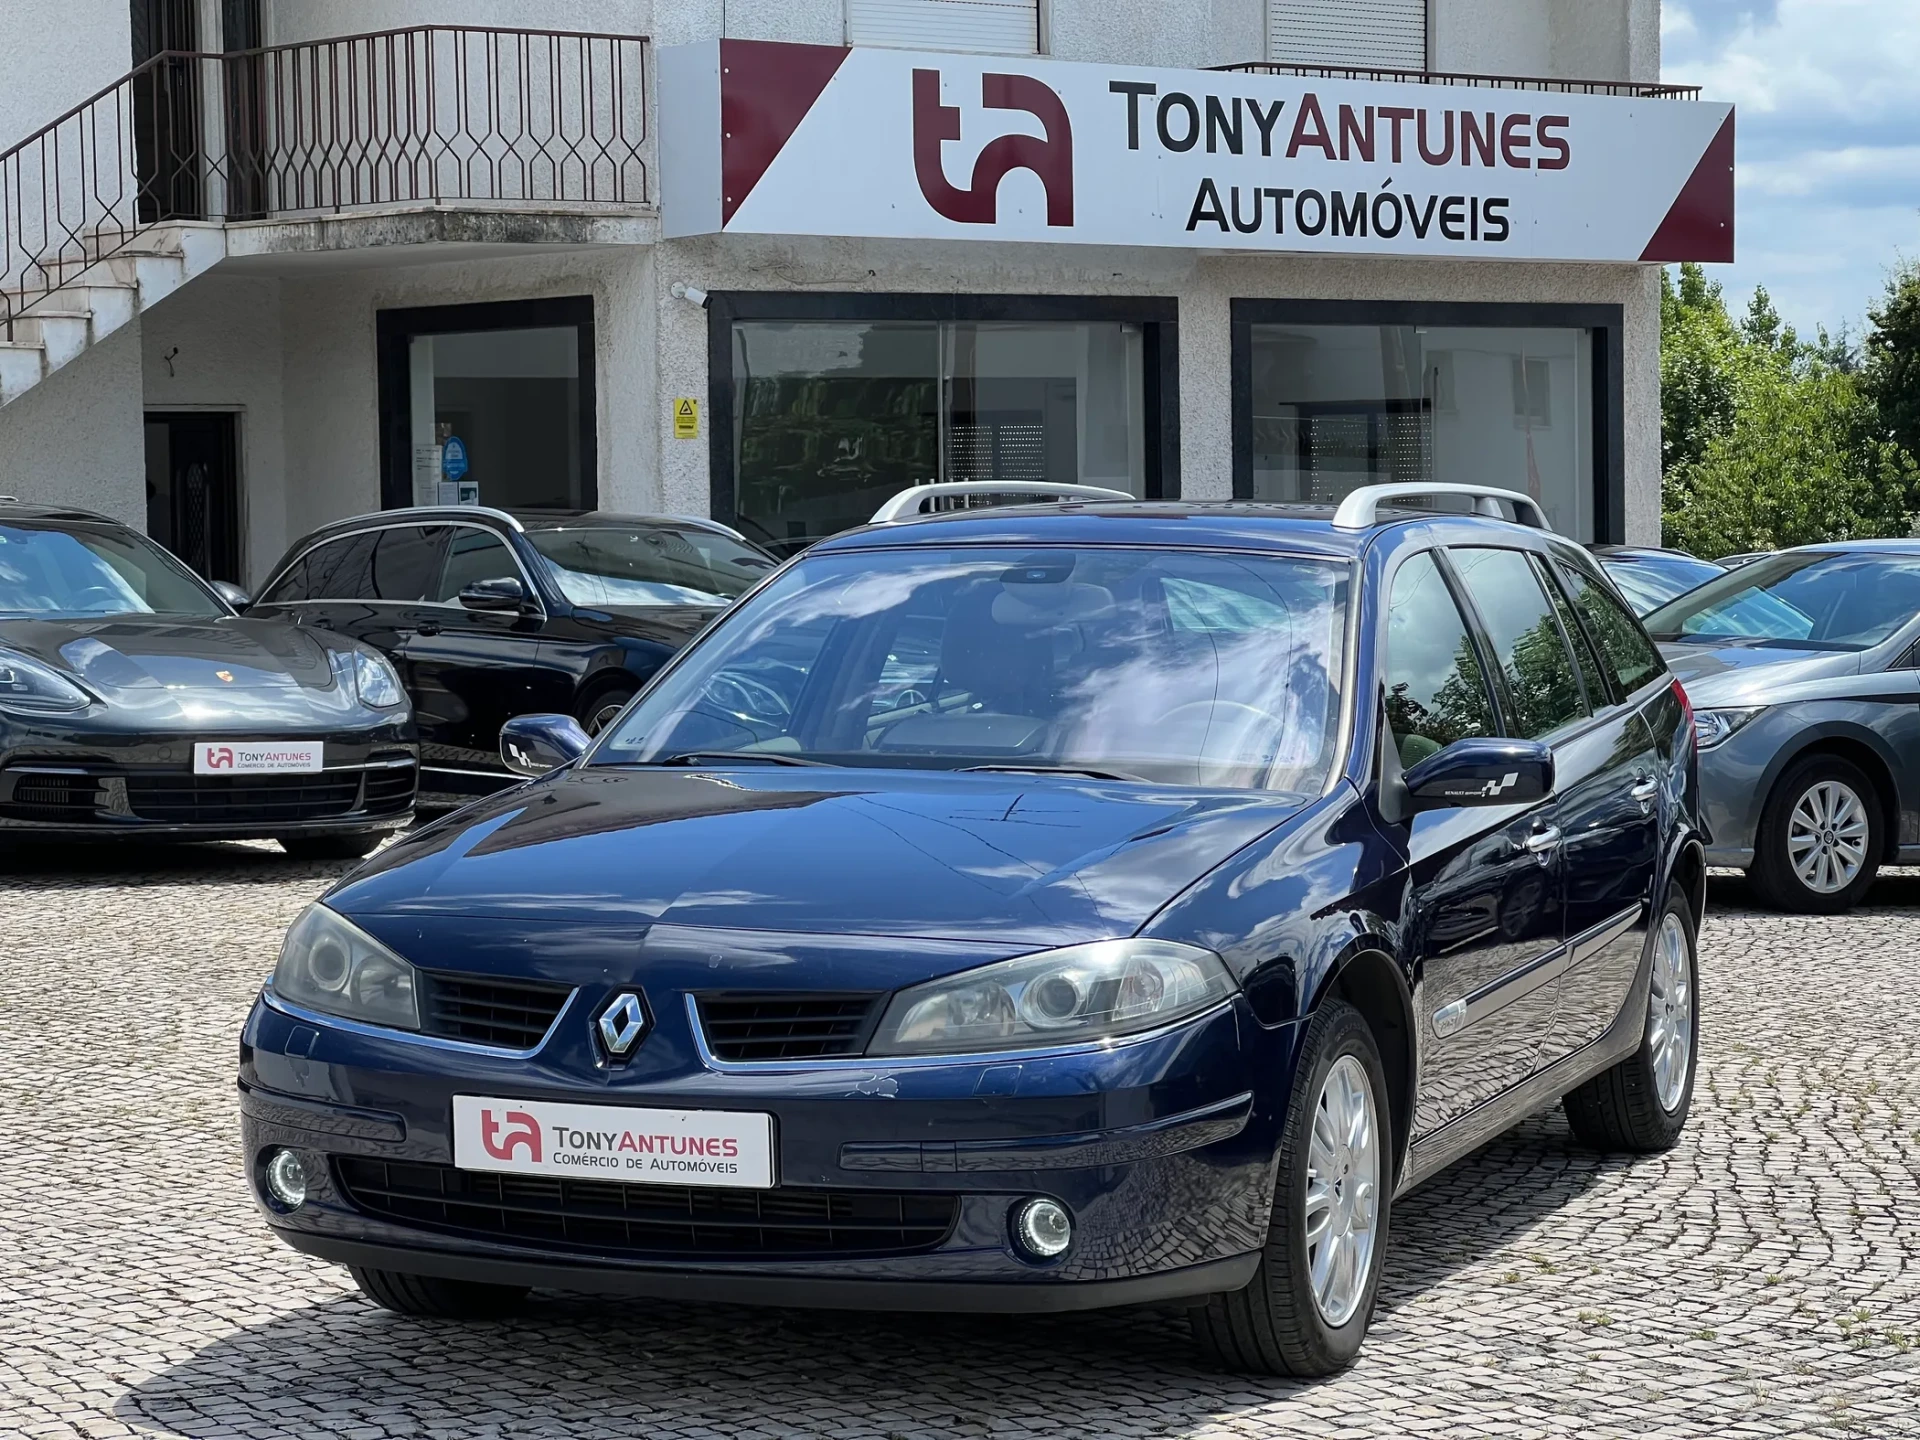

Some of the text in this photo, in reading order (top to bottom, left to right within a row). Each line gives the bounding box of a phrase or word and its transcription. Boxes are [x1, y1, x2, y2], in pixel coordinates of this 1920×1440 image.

[1185, 176, 1510, 242] AUTOMÓVEIS
[553, 1152, 738, 1174] COMÉRCIO DE AUTOMÓVEIS
